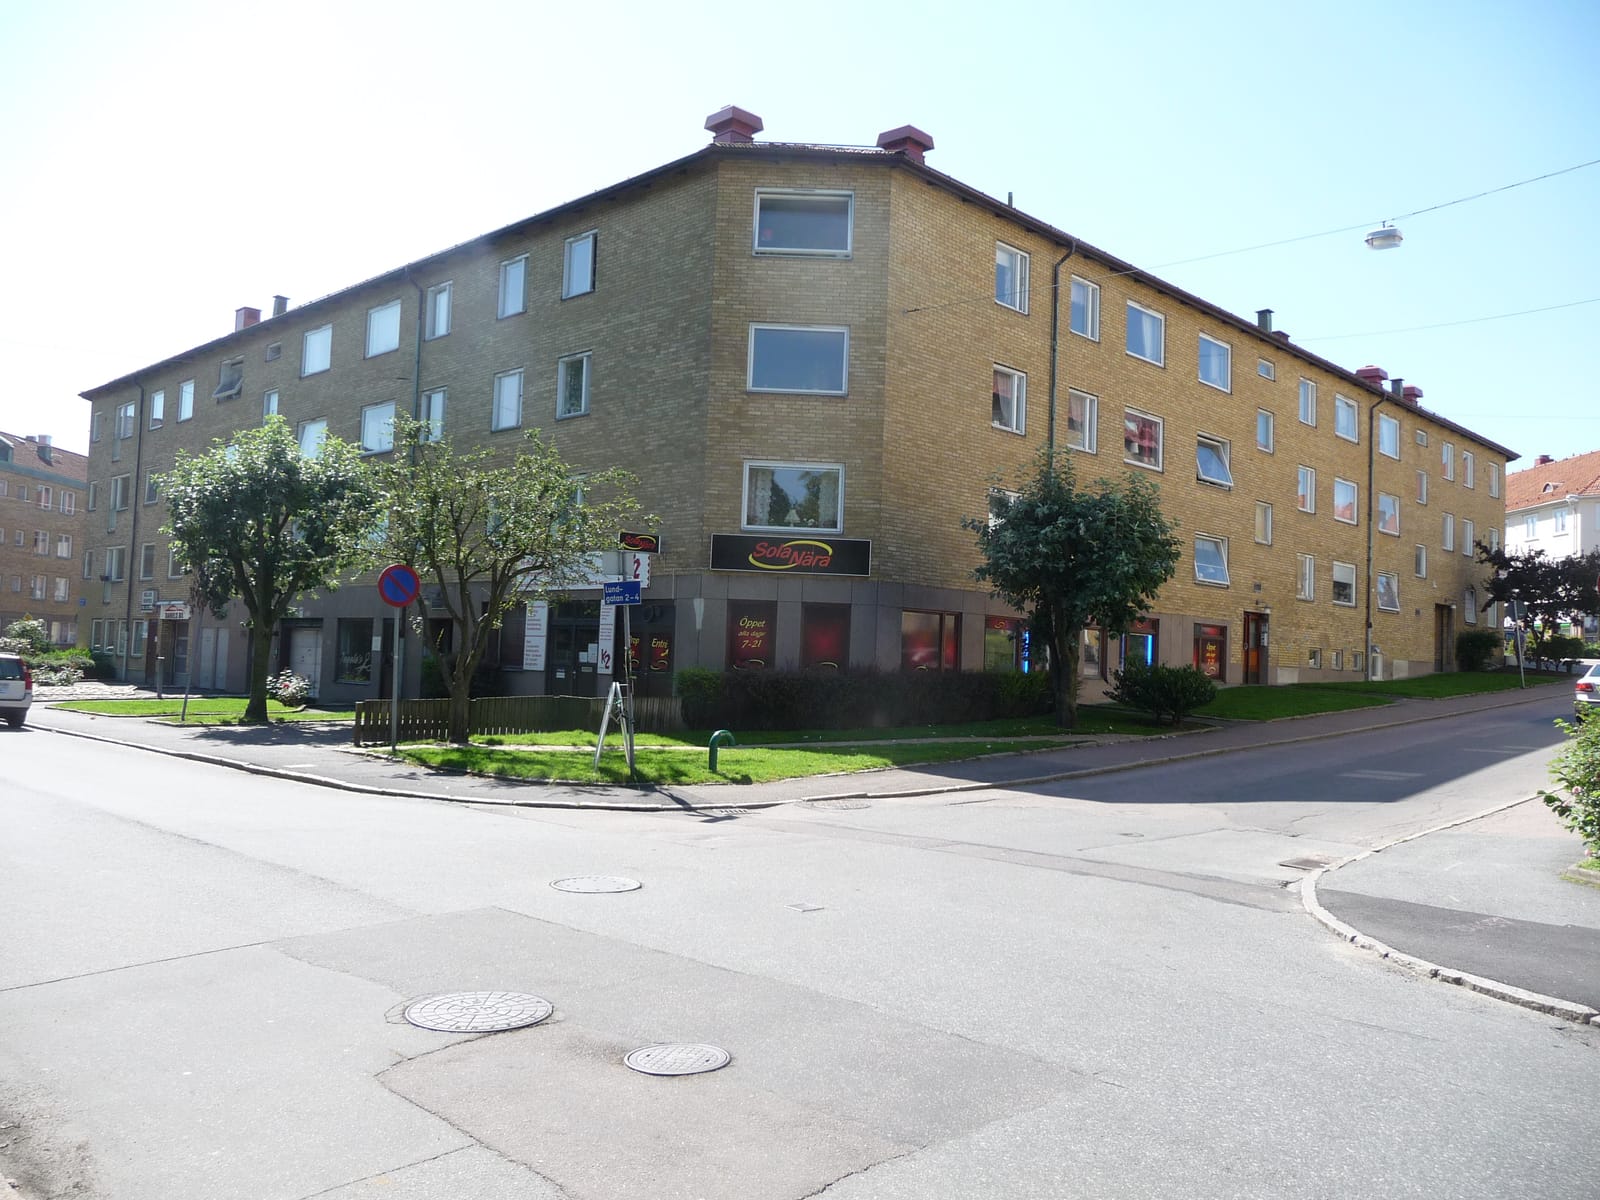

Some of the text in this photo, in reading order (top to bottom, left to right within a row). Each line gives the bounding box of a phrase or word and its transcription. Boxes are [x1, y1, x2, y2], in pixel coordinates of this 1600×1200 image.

[753, 540, 832, 567] Sola Nära
[605, 585, 624, 594] Lund-
[605, 593, 640, 603] gatan 2-4
[740, 615, 766, 629] Öppet
[741, 639, 762, 648] 7-21
[600, 649, 611, 670] K2
